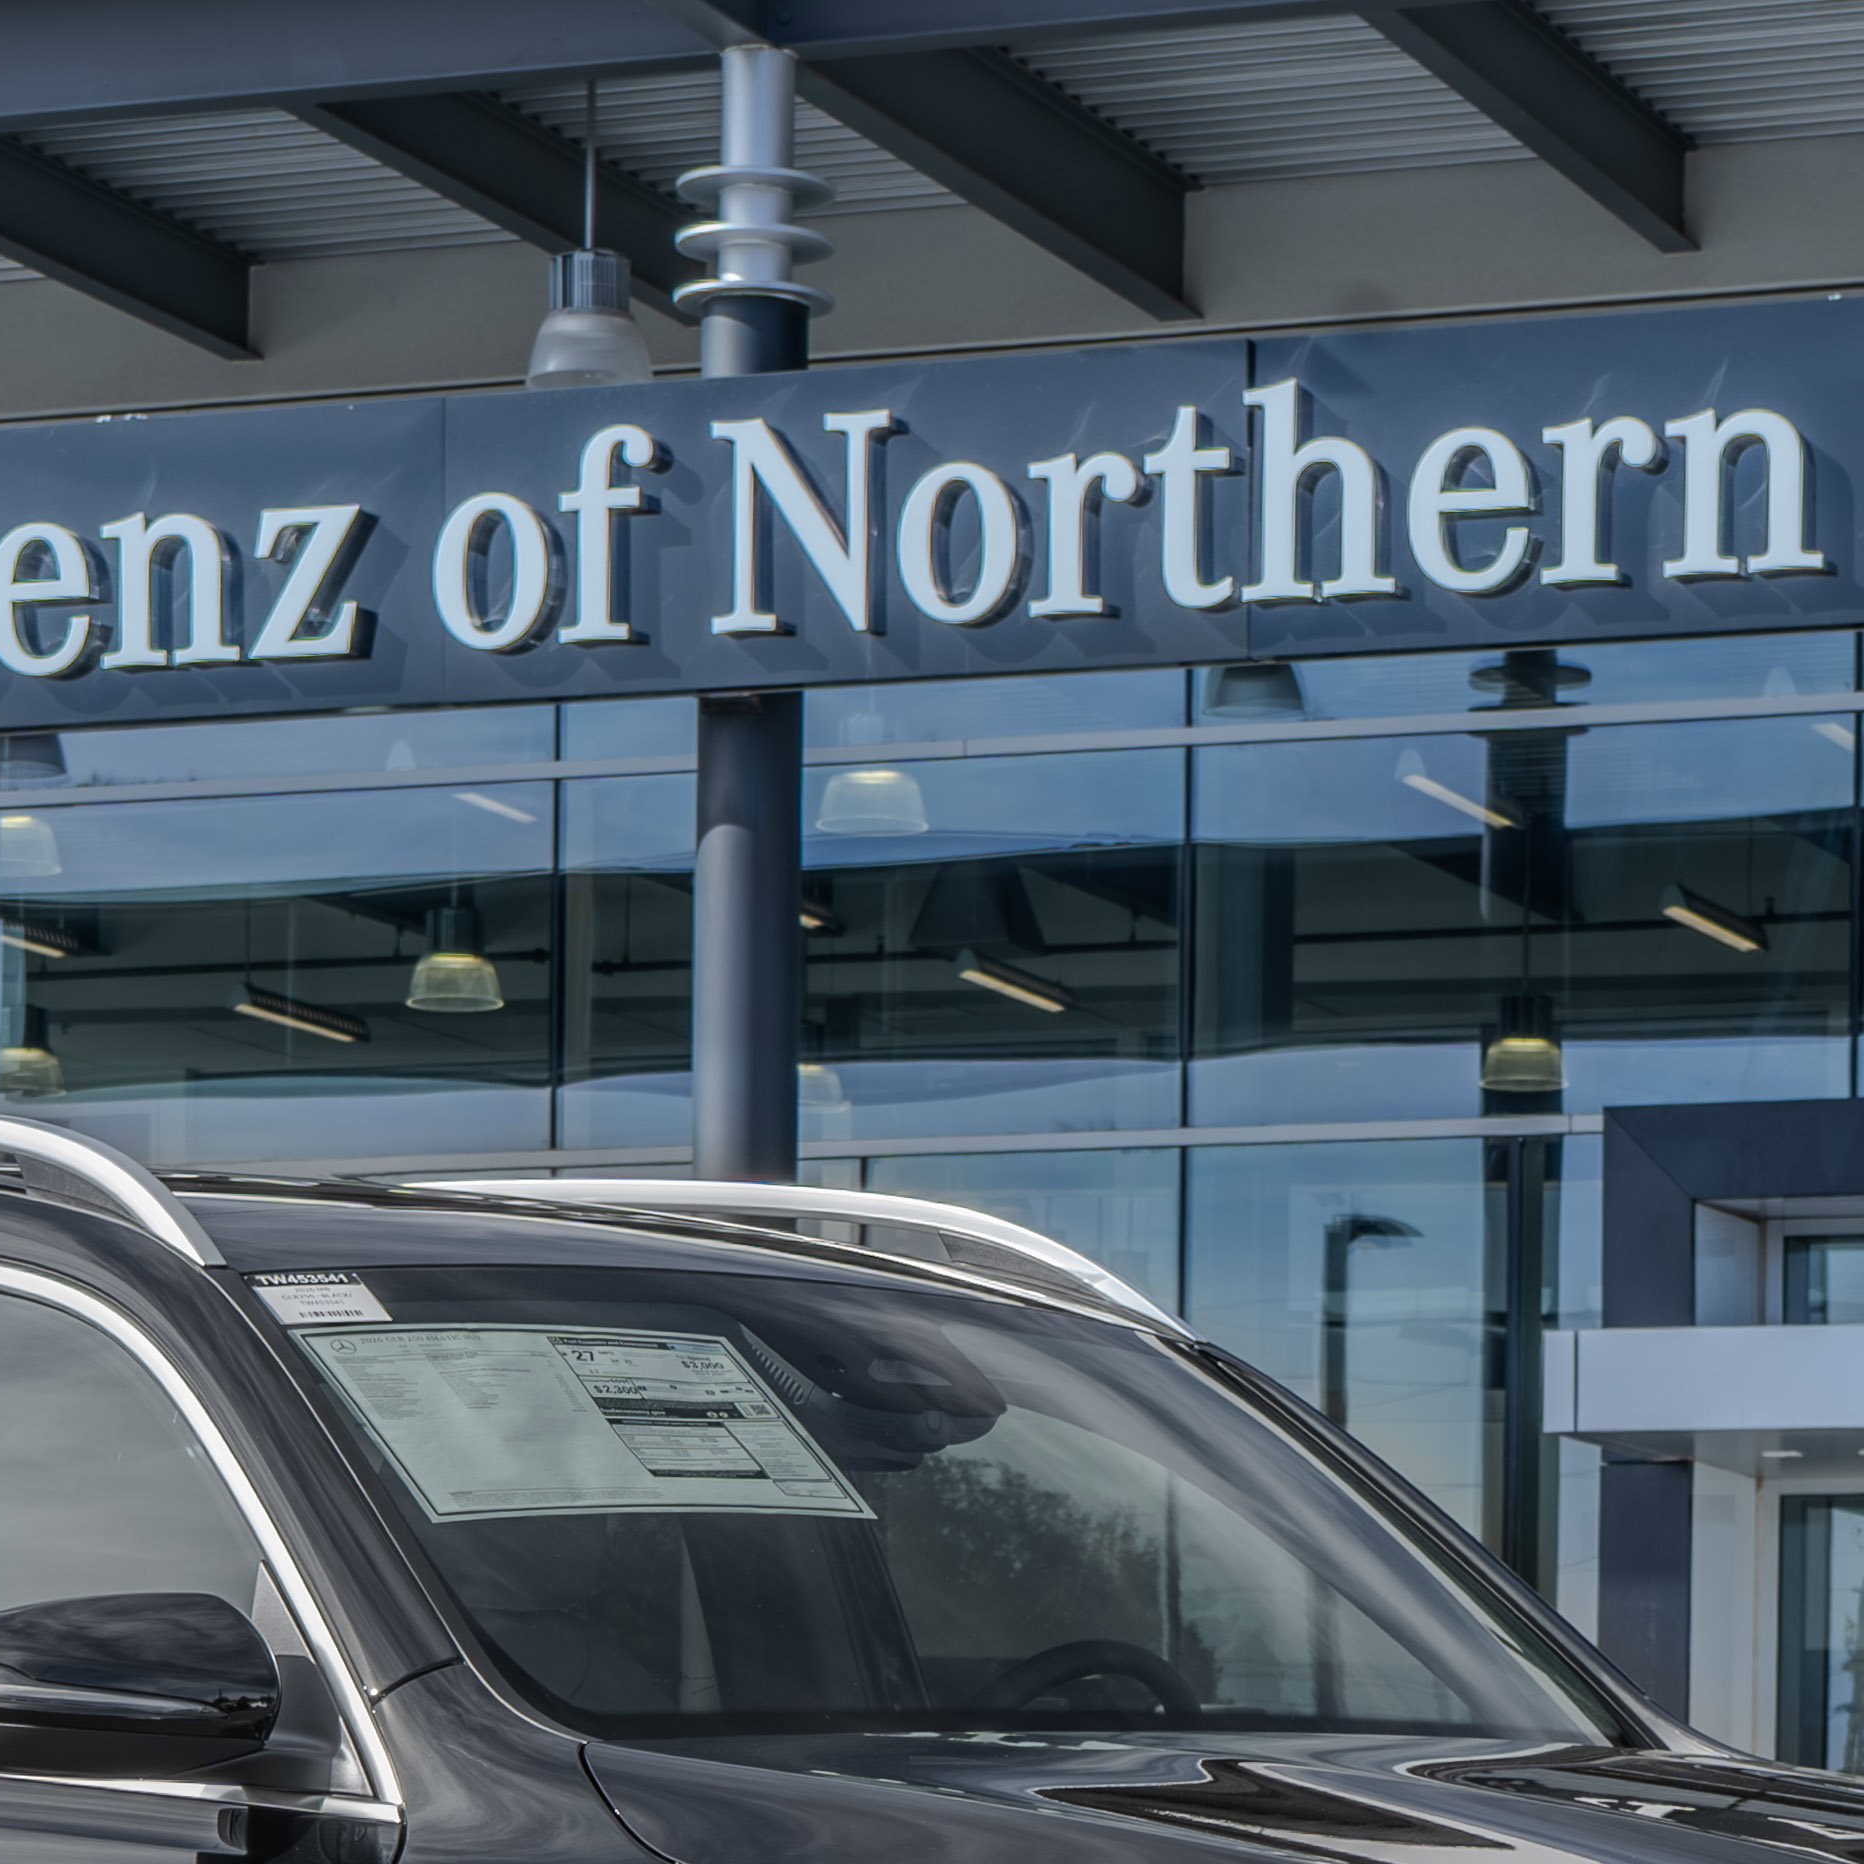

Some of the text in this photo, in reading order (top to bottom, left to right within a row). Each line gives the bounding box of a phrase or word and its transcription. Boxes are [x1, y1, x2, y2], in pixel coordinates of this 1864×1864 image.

[431, 422, 660, 652] of
[709, 377, 1826, 636] Northern
[254, 1272, 350, 1286] TW453541
[571, 1349, 595, 1362] 27
